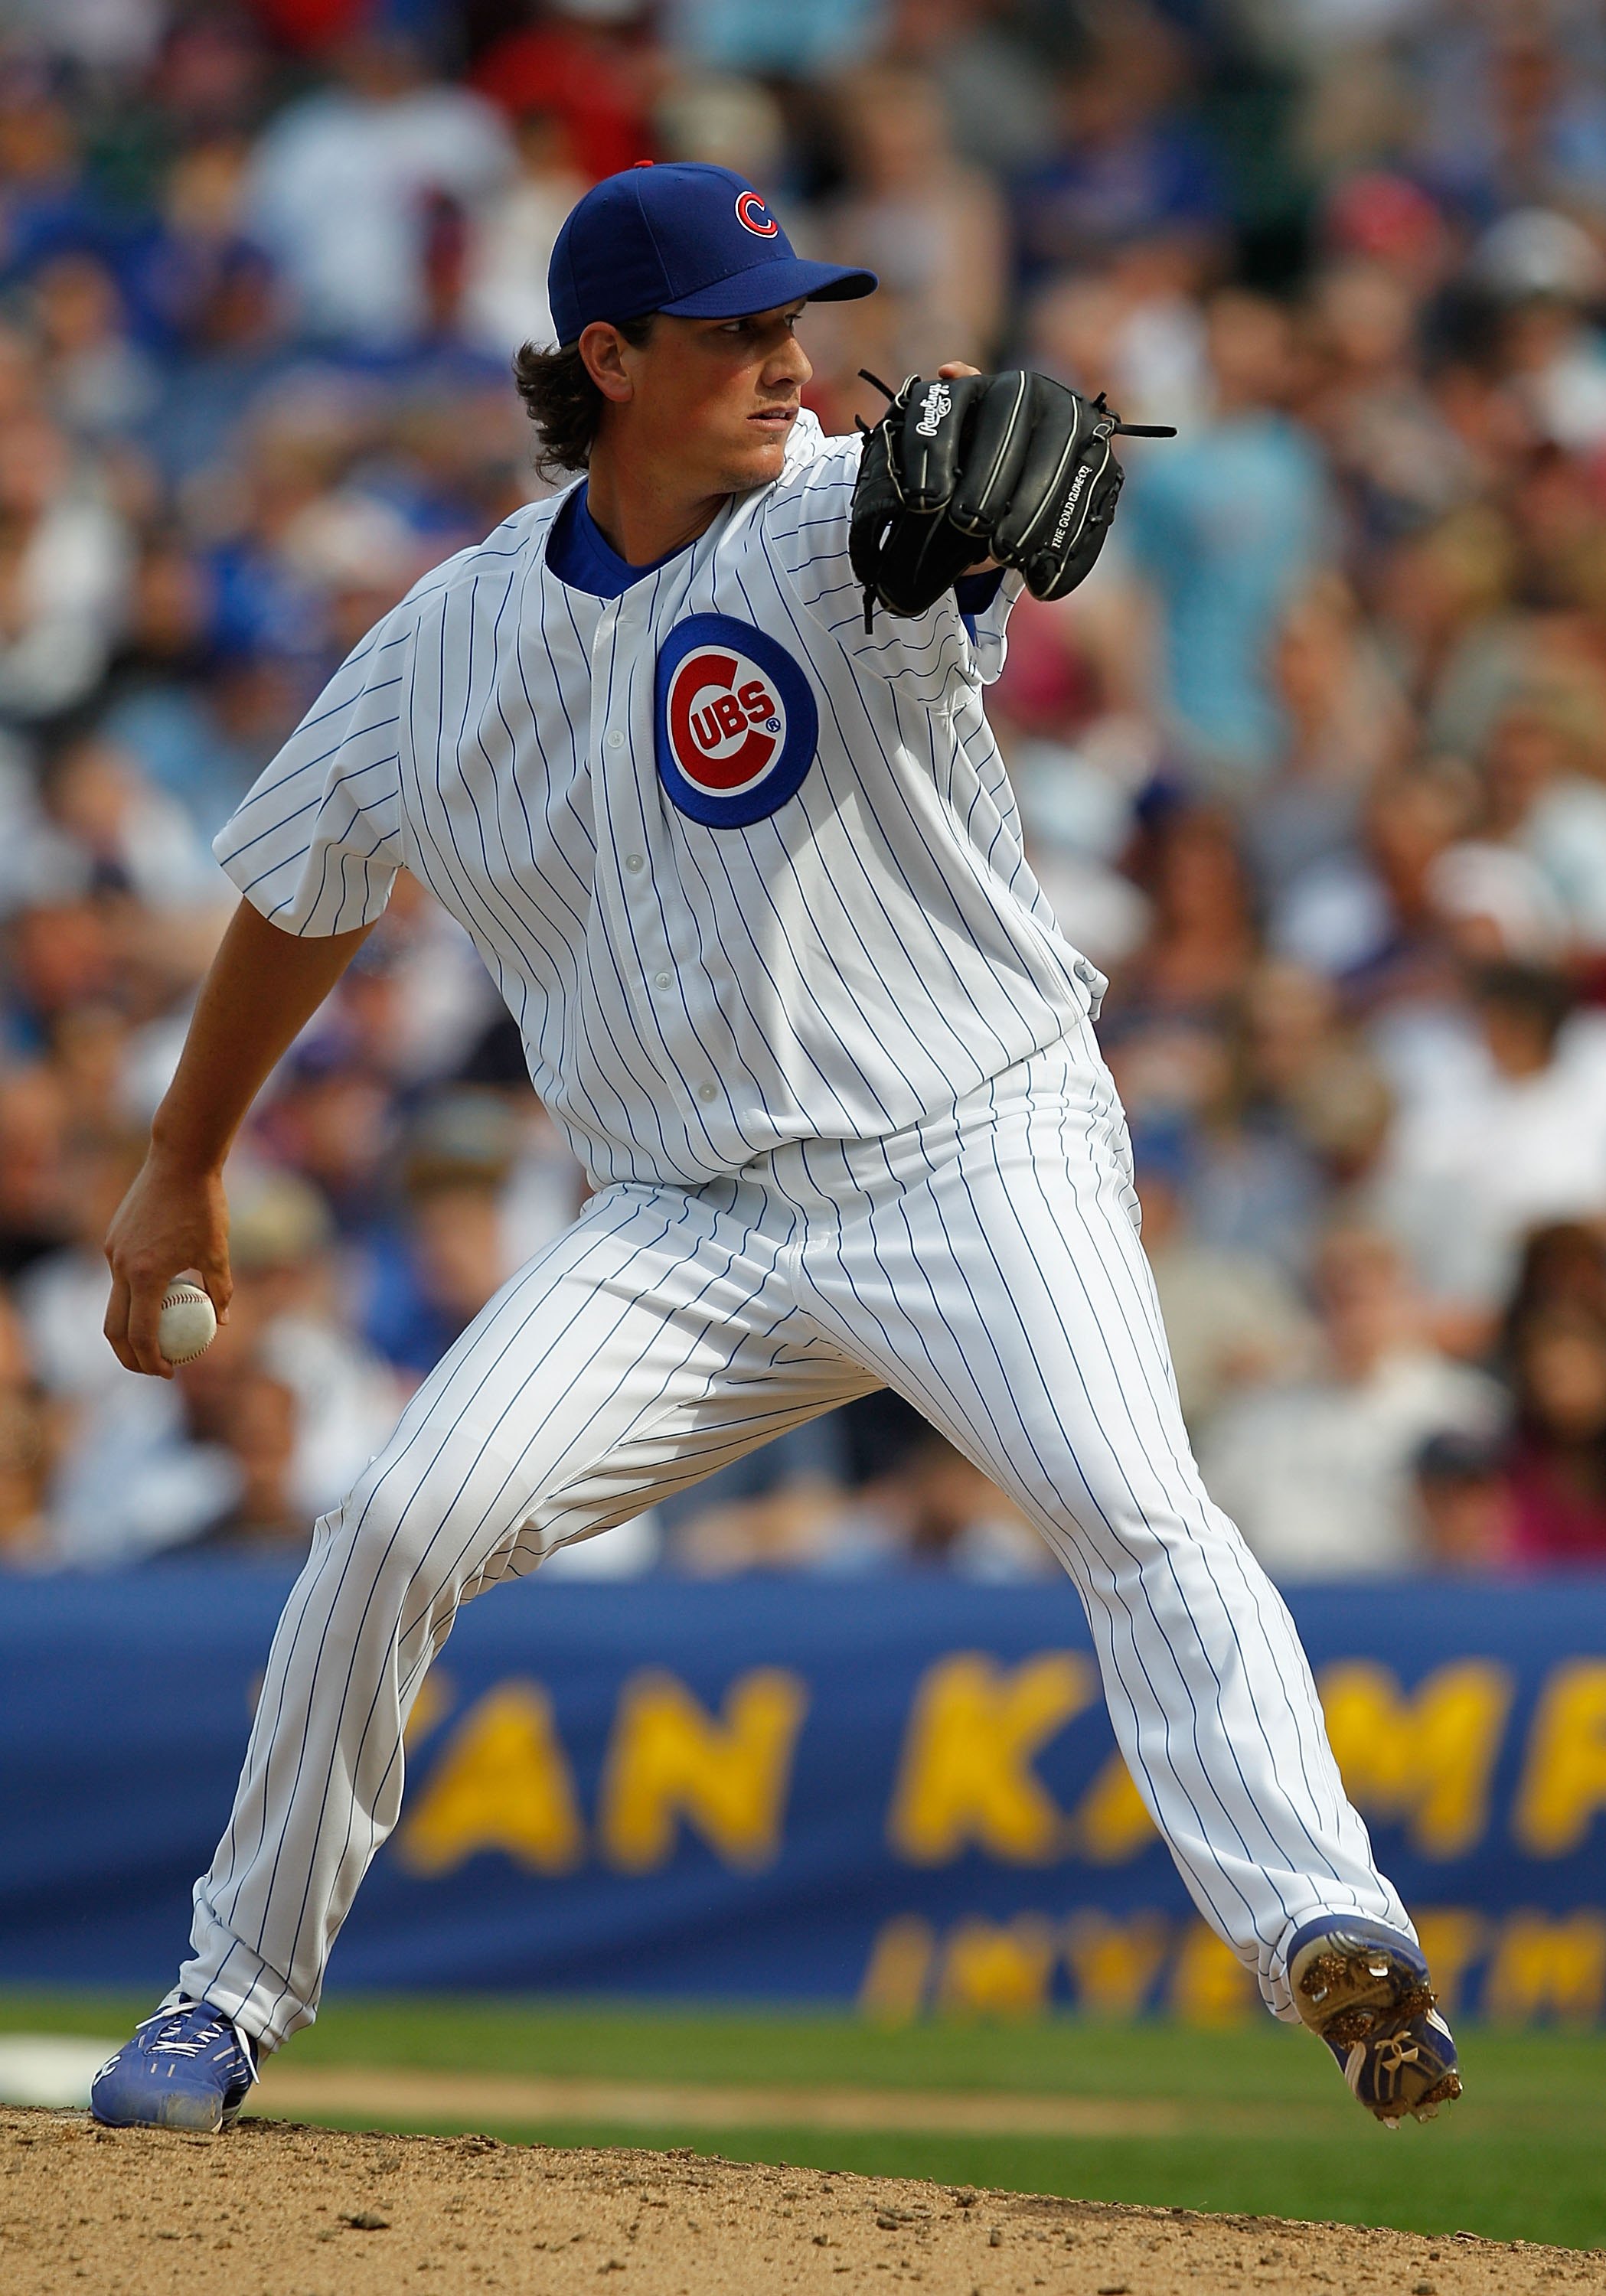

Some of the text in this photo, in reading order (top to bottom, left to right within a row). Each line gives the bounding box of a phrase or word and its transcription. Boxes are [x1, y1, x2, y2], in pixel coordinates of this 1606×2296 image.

[736, 191, 779, 239] C
[916, 383, 950, 436] Rawlings
[1051, 527, 1066, 549] THE
[1059, 501, 1076, 527] GOLD
[1069, 476, 1085, 502] GLOVE
[671, 654, 776, 790] CUBS
